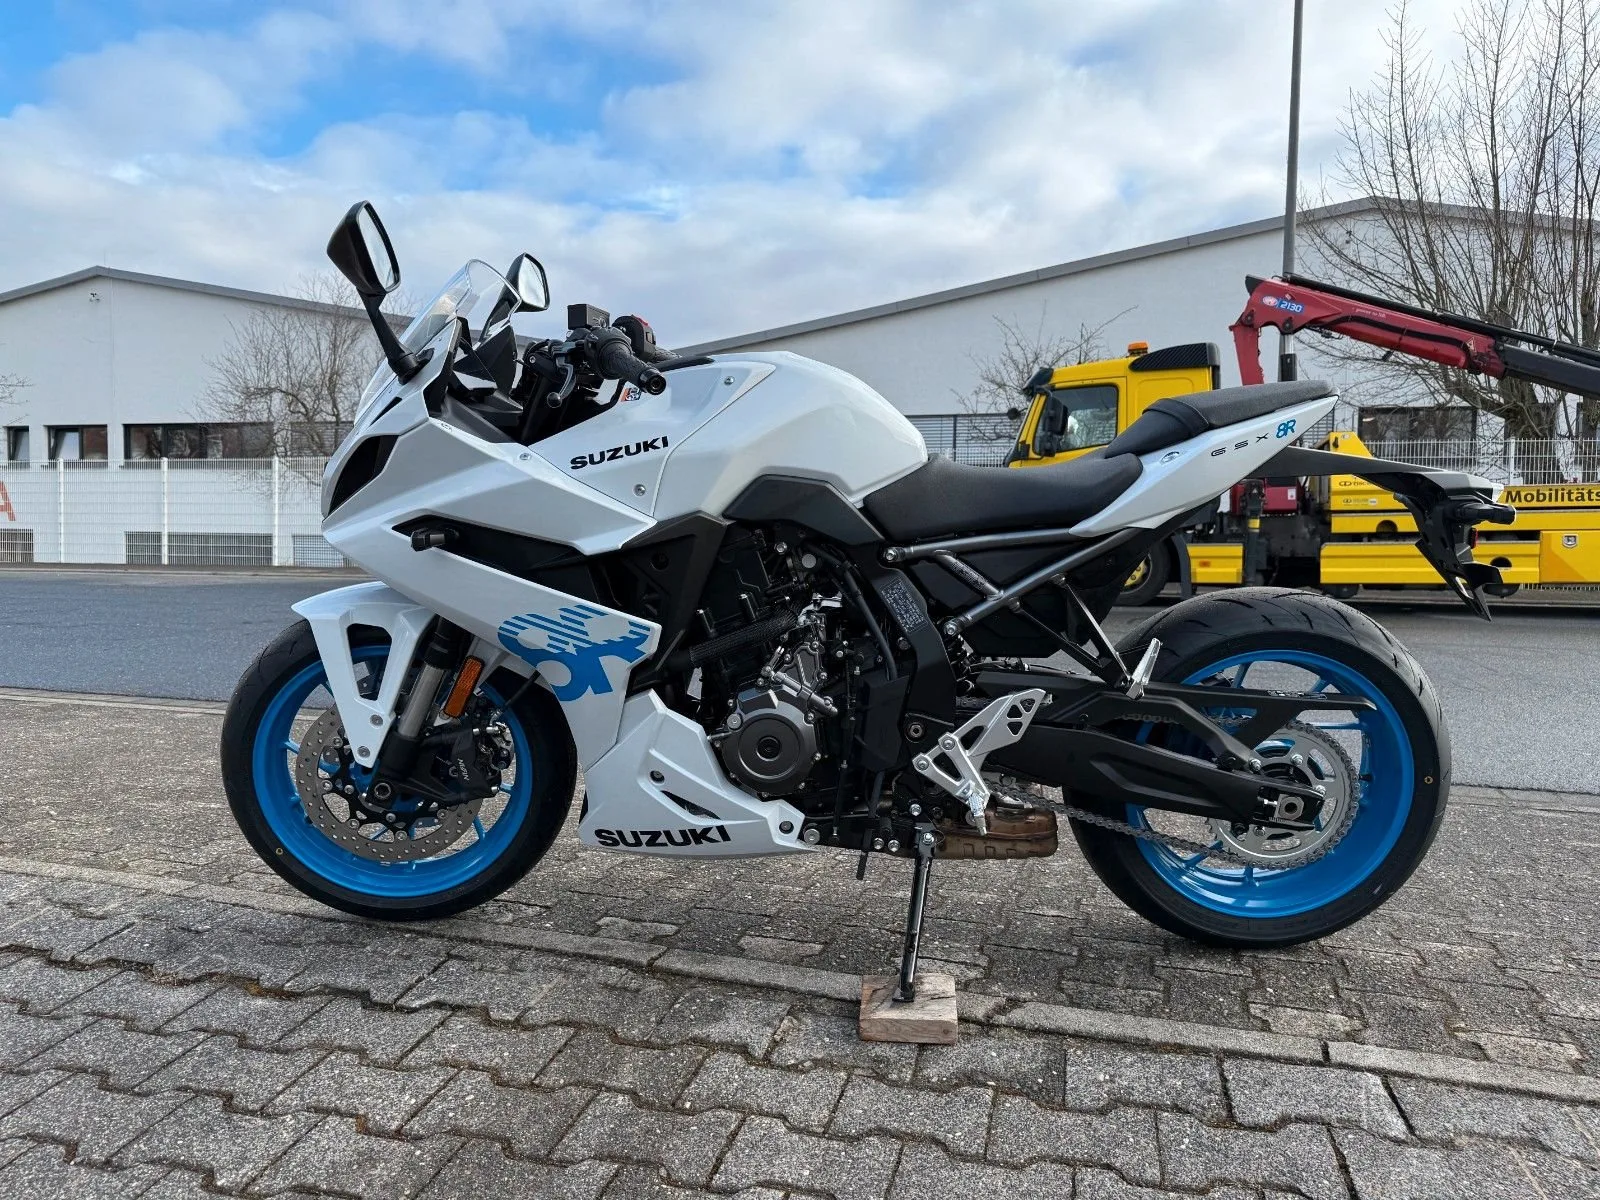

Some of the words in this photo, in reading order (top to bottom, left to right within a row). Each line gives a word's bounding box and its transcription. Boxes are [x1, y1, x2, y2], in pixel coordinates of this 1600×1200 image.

[1280, 300, 1302, 313] 2130
[1275, 418, 1297, 439] 8R
[570, 436, 669, 470] SUZUKI
[594, 825, 731, 847] SUZUKI
